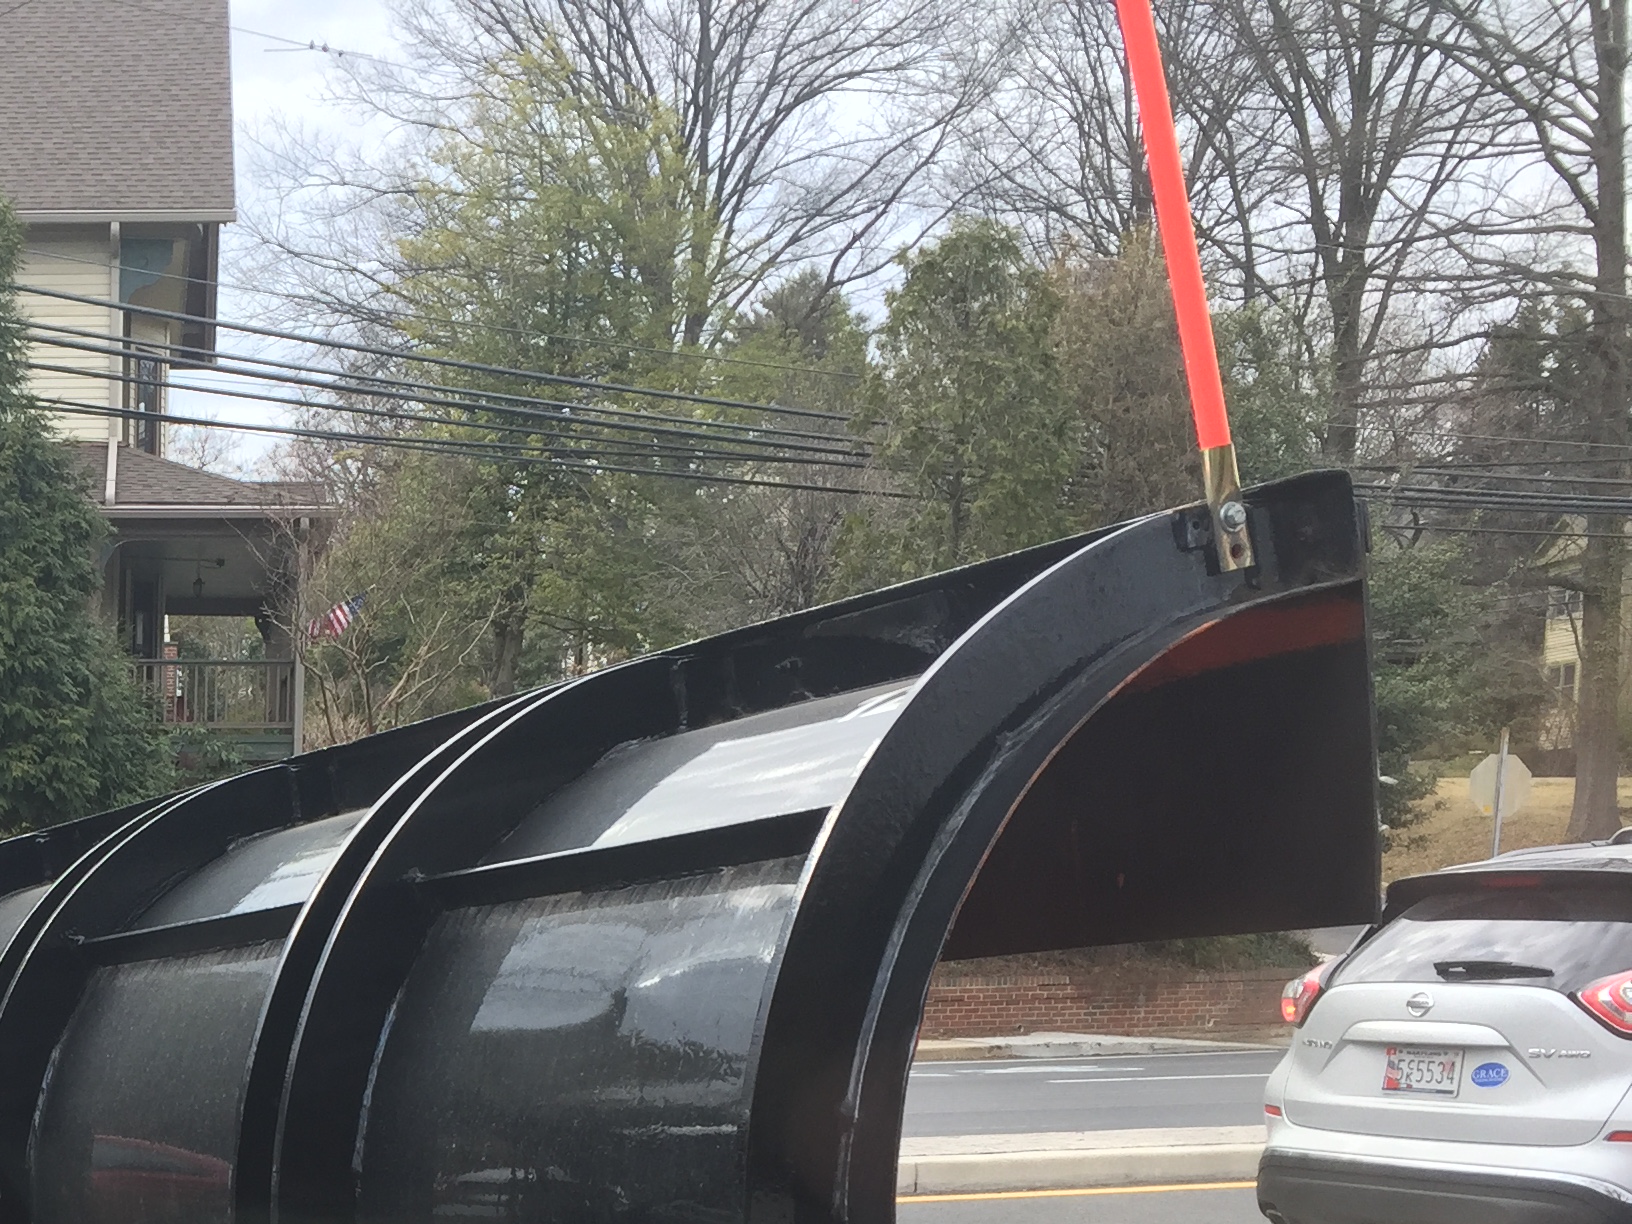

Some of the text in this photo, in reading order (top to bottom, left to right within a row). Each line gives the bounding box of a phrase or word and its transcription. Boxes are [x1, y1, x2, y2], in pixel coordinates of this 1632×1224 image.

[1528, 1048, 1591, 1059] SV AWD
[1472, 1068, 1508, 1079] GRACE
